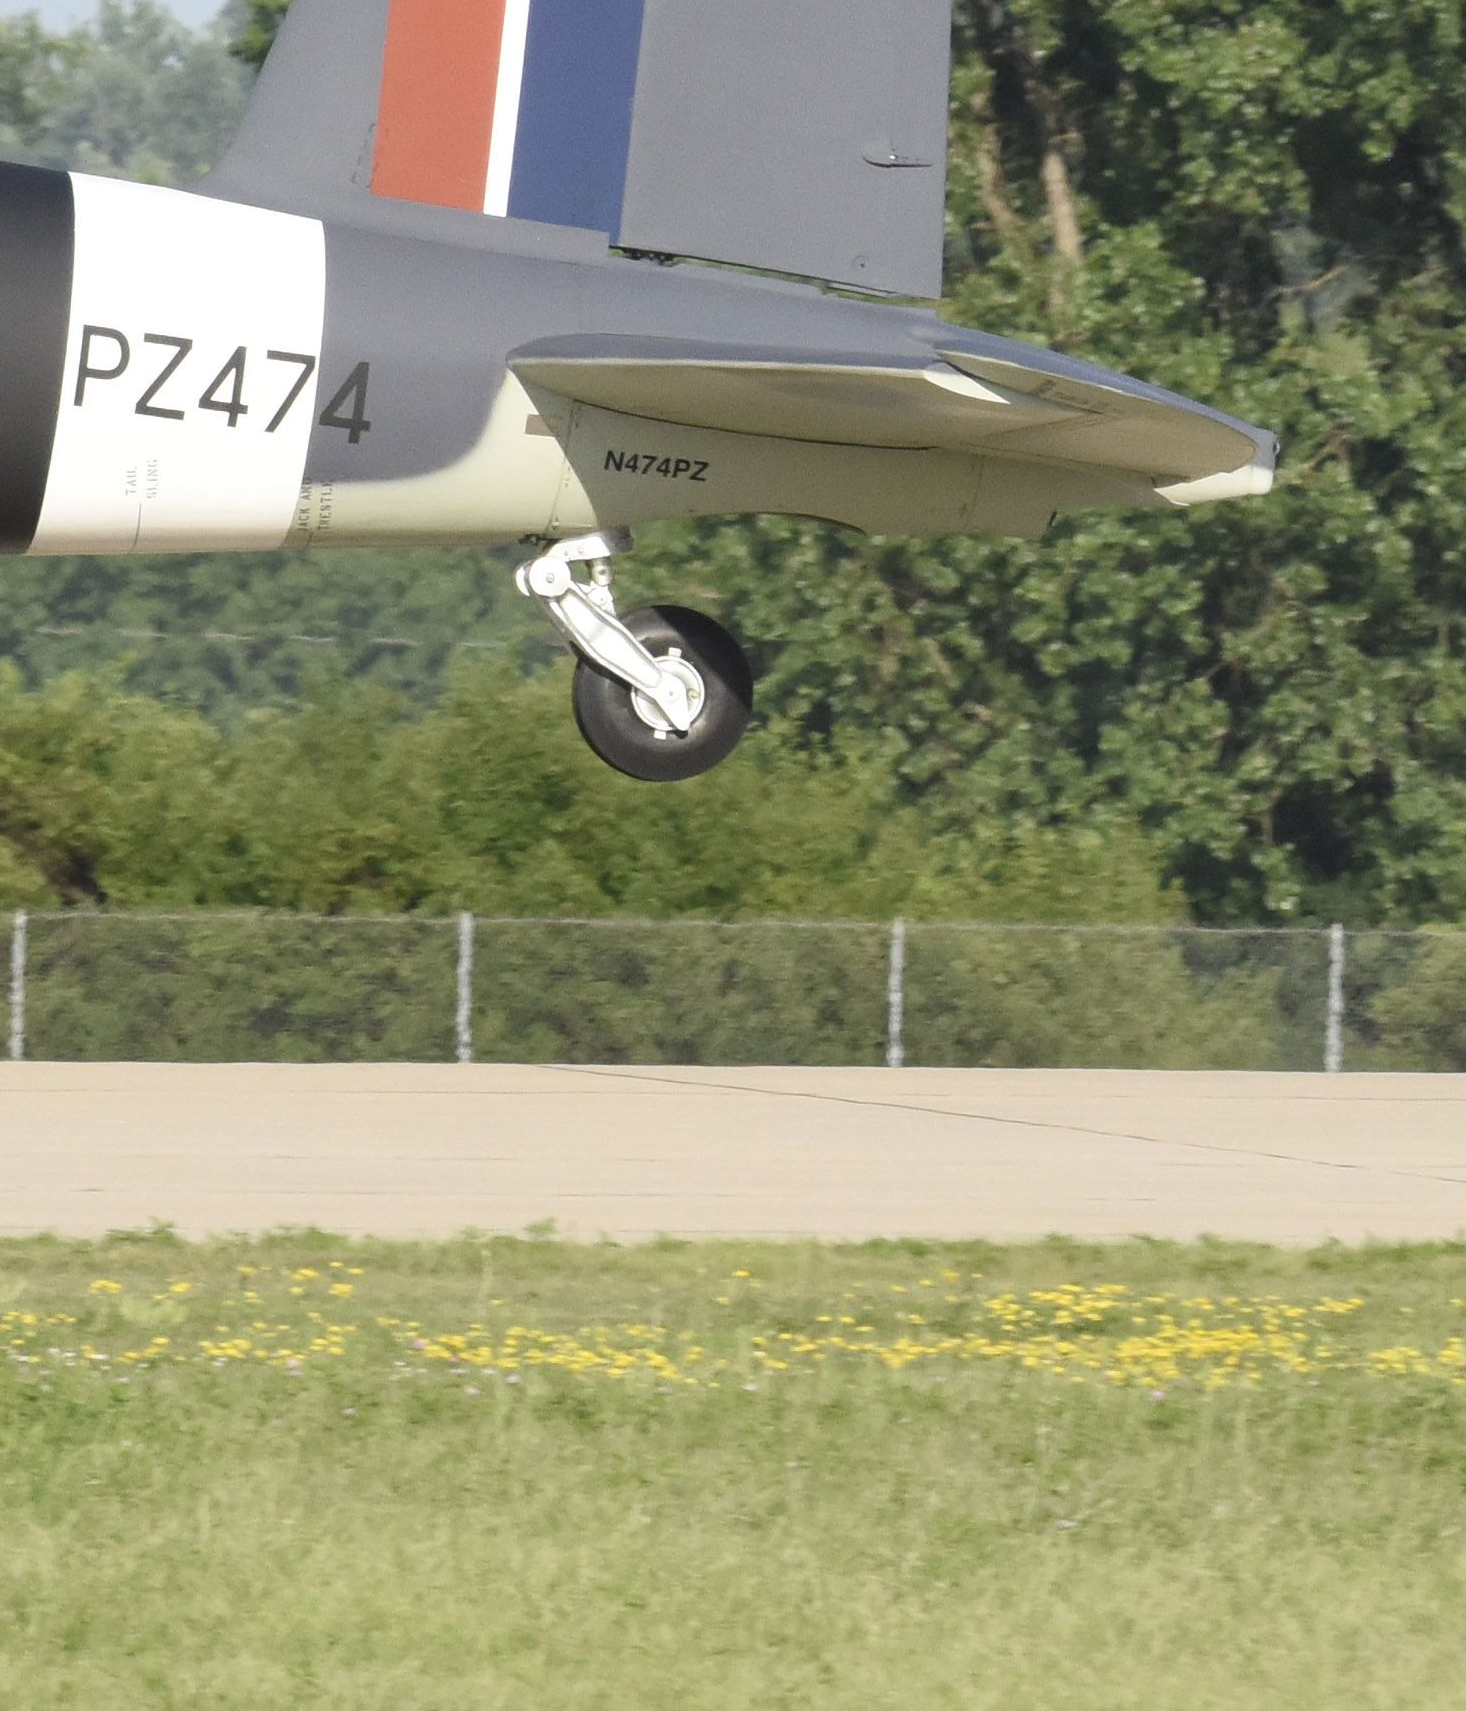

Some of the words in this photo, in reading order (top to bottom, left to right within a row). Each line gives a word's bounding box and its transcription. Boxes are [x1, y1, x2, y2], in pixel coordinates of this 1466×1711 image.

[74, 324, 371, 444] PZ474
[604, 450, 710, 482] N474PZ
[297, 508, 311, 531] JACK
